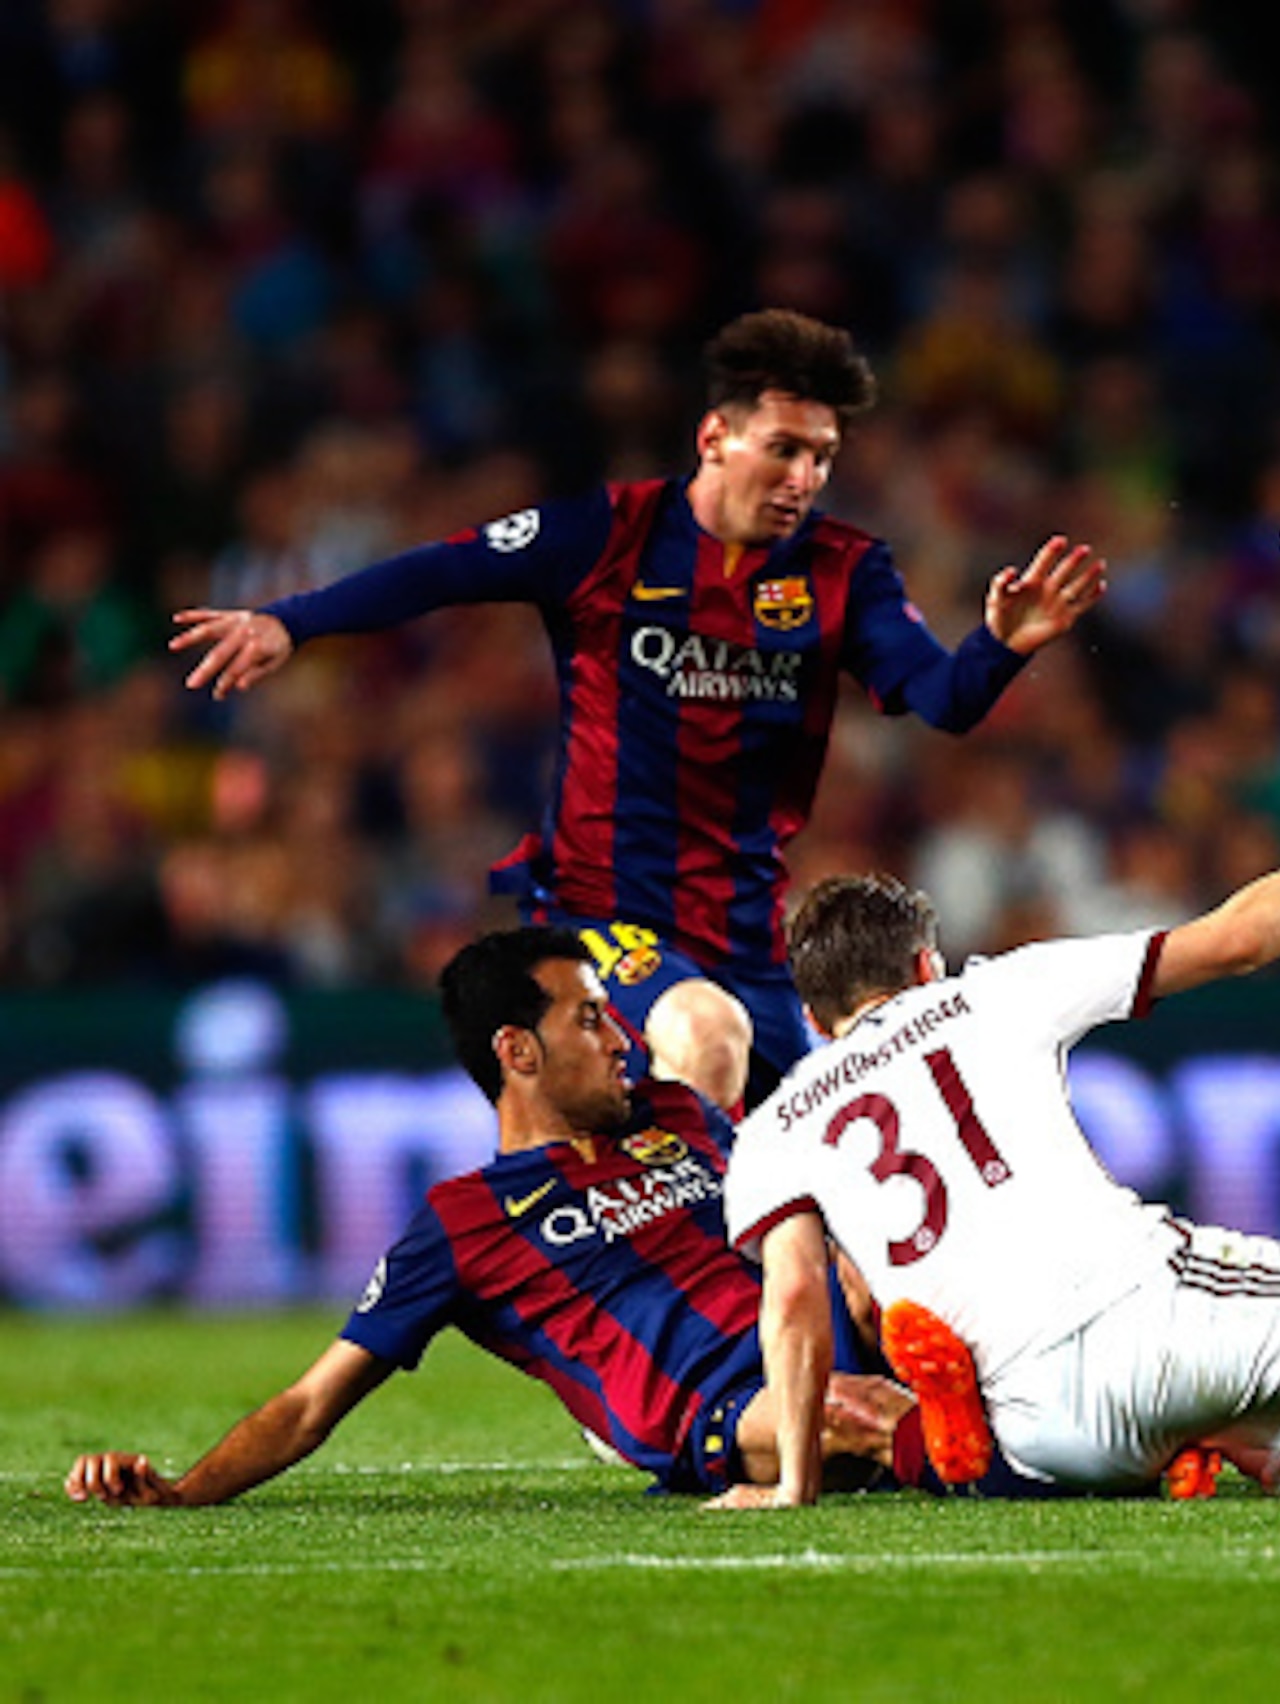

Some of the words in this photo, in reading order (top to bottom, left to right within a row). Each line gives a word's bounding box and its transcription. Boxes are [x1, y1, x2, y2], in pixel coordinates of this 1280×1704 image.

[630, 626, 802, 678] QATAR
[666, 670, 799, 701] AIRWAYS
[777, 992, 972, 1131] SCHWEINSTEIGER
[822, 1046, 1014, 1267] 31
[540, 1157, 704, 1245] QATAR
[601, 1168, 724, 1244] AIRWAYS
